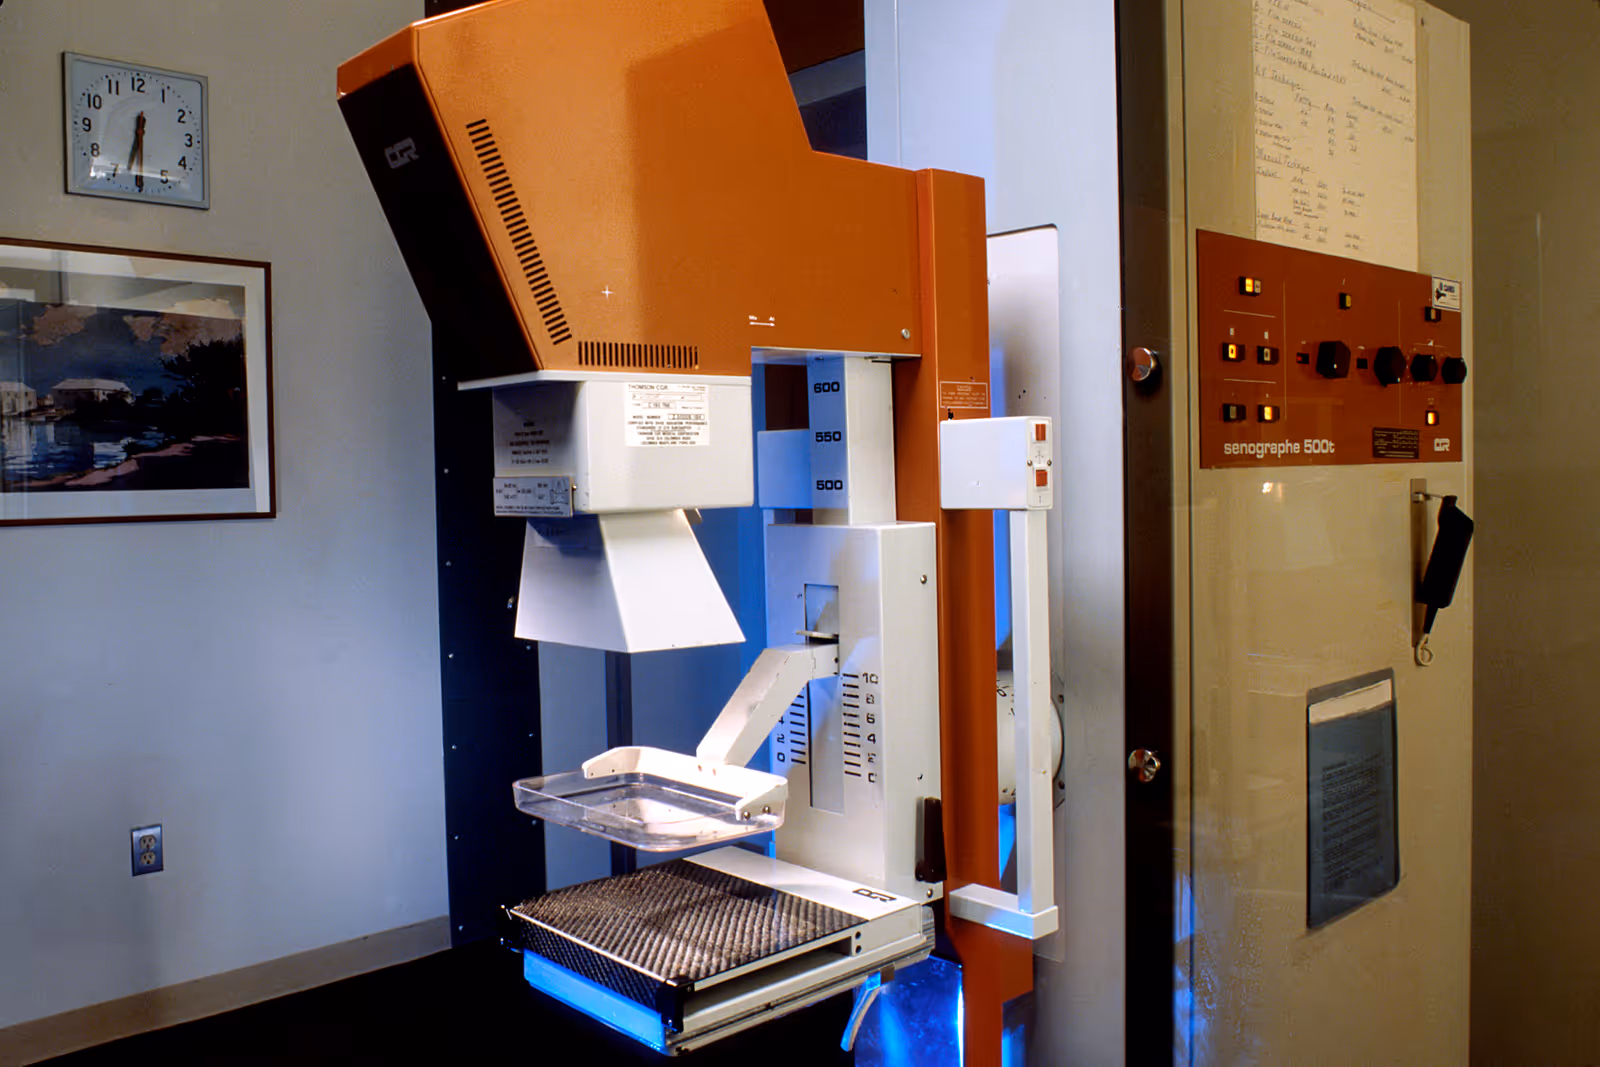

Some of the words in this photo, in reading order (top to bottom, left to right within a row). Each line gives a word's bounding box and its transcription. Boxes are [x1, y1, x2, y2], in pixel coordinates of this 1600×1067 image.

[107, 78, 120, 96] 11
[131, 76, 145, 93] 12
[87, 93, 102, 110] 10
[160, 88, 165, 103] 1
[177, 108, 186, 124] 2
[82, 117, 92, 132] 9
[184, 133, 193, 148] 3
[90, 142, 100, 157] 8
[110, 162, 119, 178] 7
[177, 155, 187, 170] 4
[160, 169, 168, 184] 5
[813, 382, 840, 393] 600
[815, 431, 841, 442] 550
[1223, 439, 1301, 459] senographe
[1303, 438, 1335, 454] 500t
[816, 479, 843, 490] 500
[862, 672, 879, 684] 10
[866, 712, 875, 724] 6
[776, 733, 785, 744] 2
[867, 733, 876, 744] 4
[776, 751, 786, 763] 0
